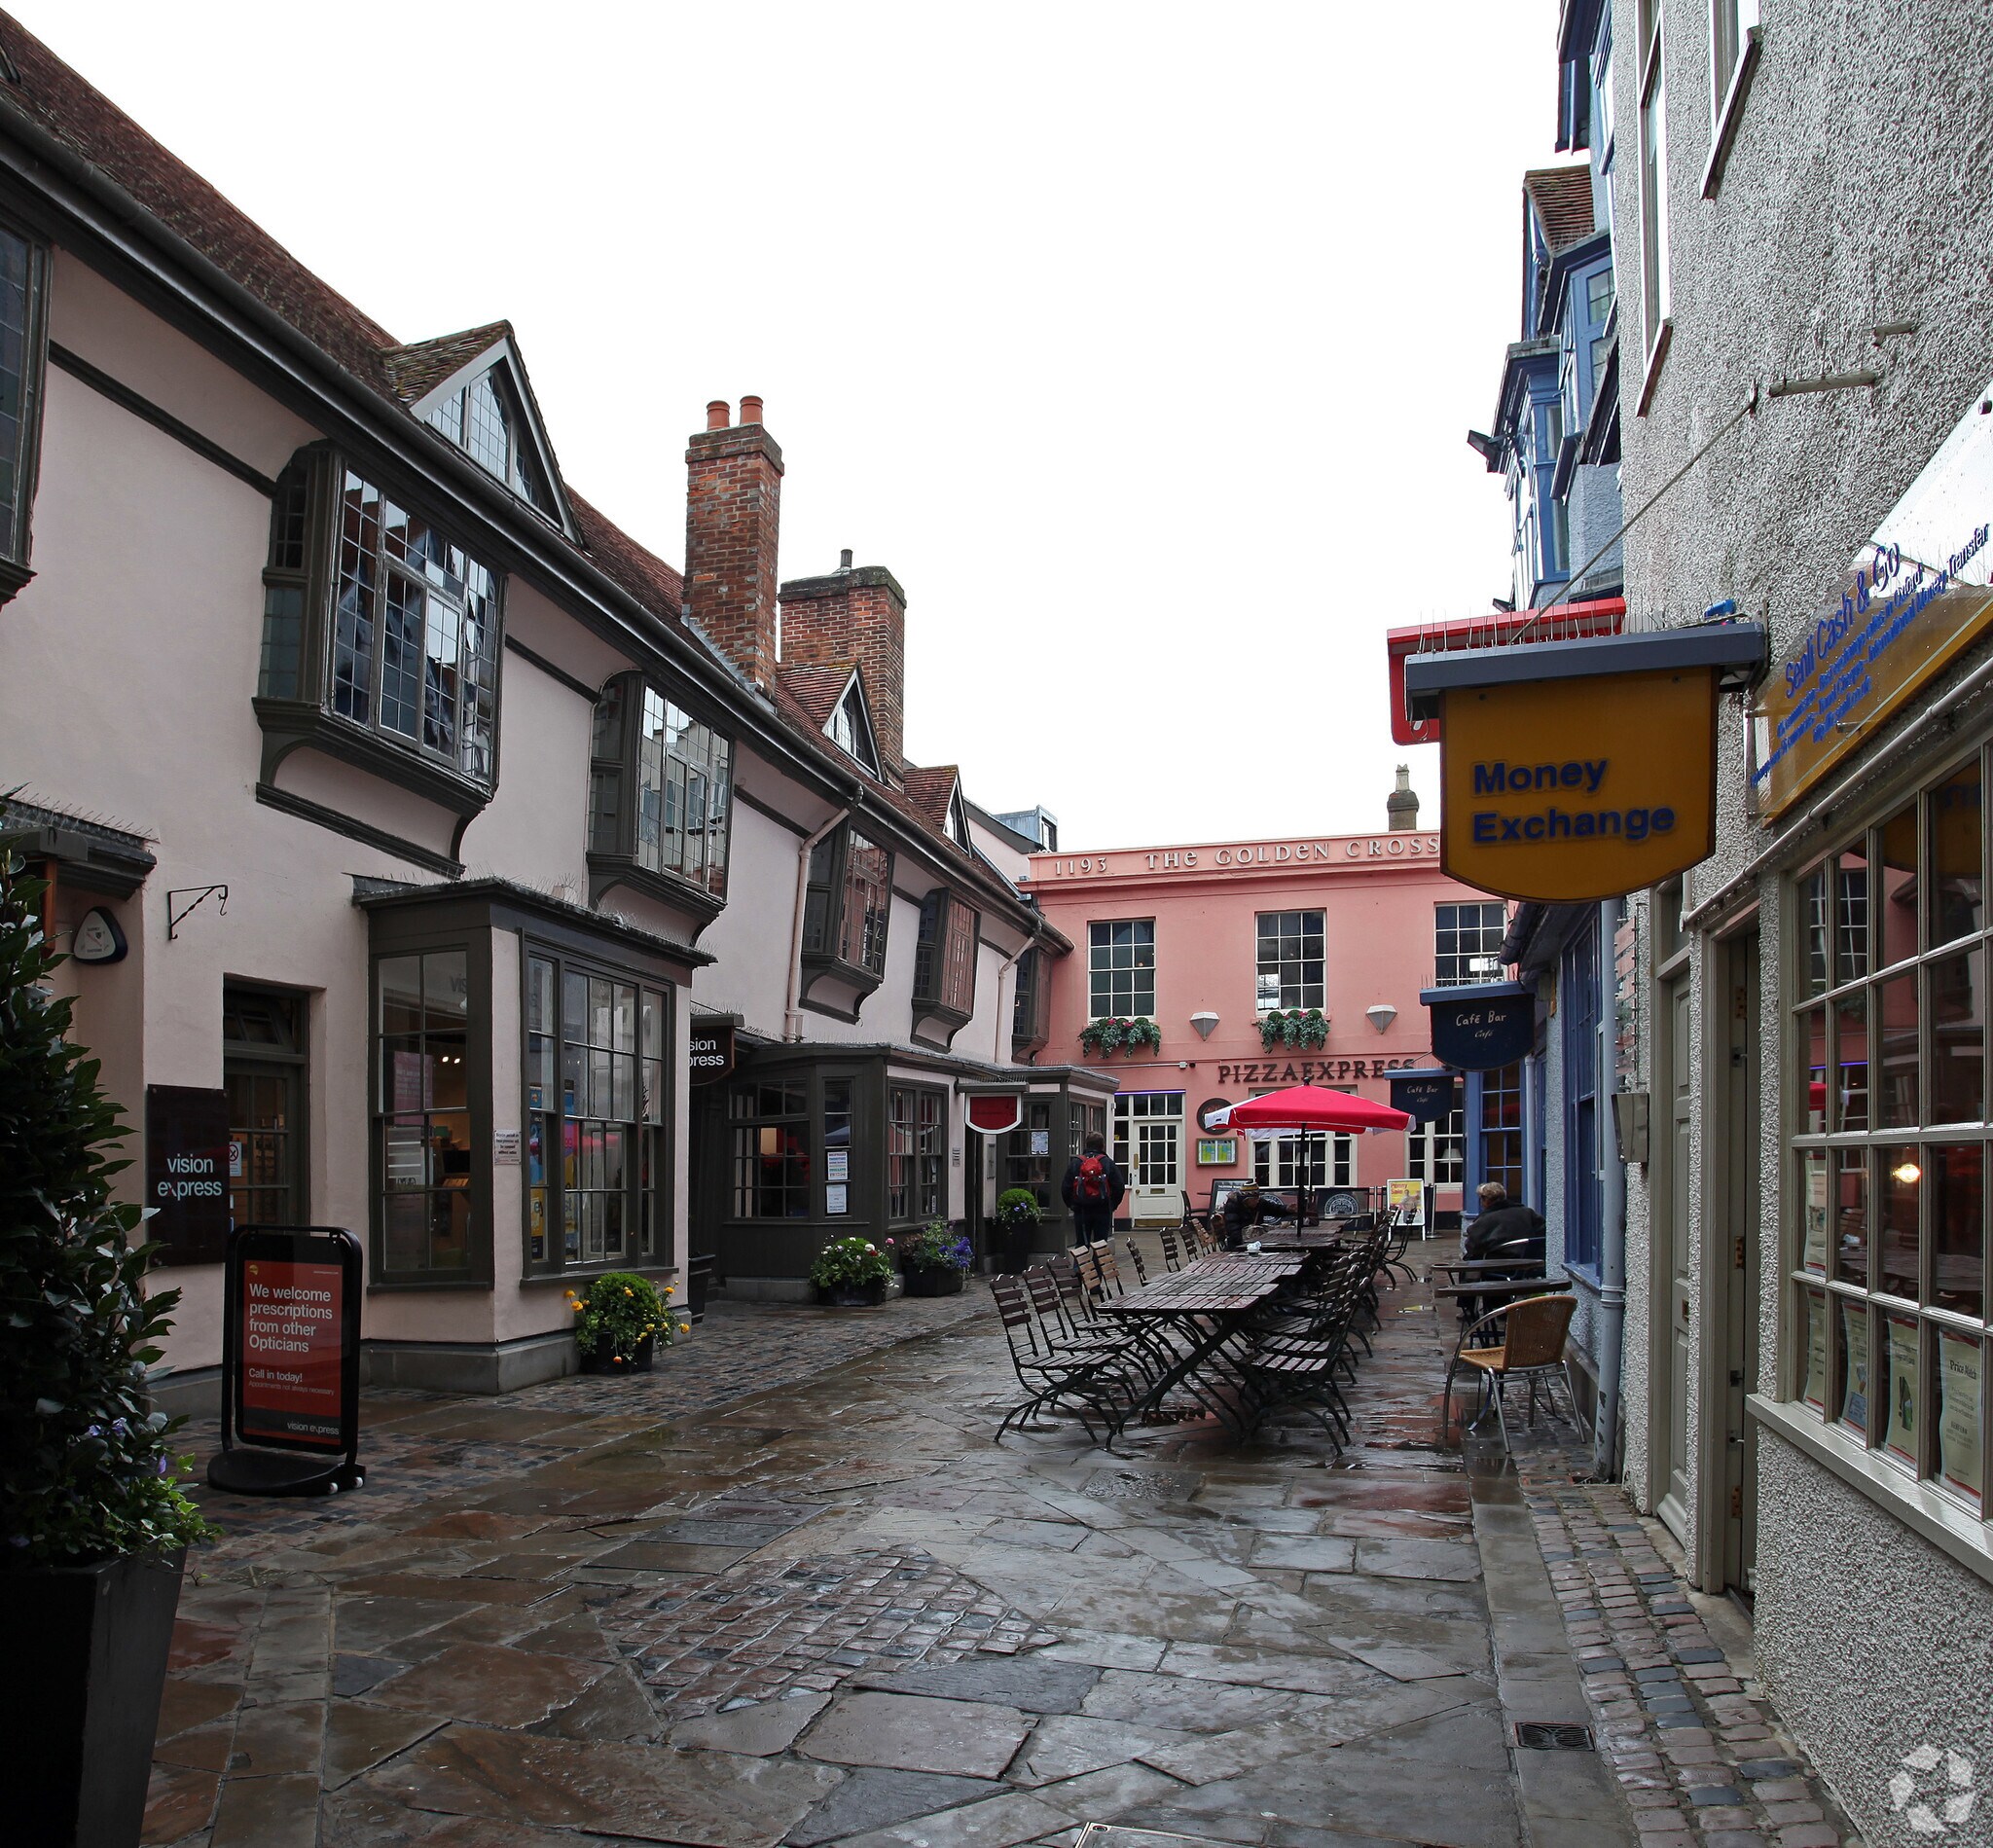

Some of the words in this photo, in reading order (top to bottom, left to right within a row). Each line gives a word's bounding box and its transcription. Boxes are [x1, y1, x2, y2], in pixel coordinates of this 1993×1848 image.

[1916, 569, 1947, 613] Money
[1946, 523, 1990, 580] Transfer
[1785, 633, 1816, 699] Senli
[1817, 592, 1854, 659] Cash
[1856, 569, 1870, 615] &
[1872, 542, 1901, 592] Go
[1472, 759, 1609, 796] Money
[1472, 807, 1676, 844] Exchange
[1055, 856, 1107, 876] 1193
[1345, 836, 1438, 858] CROSS
[1456, 1013, 1481, 1027] Café
[1487, 1010, 1507, 1024] Bar
[689, 1037, 717, 1051] sion
[1217, 1058, 1415, 1084] PIZZAEXPRESS
[1426, 1084, 1438, 1094] Bar
[166, 1153, 214, 1174] vision
[157, 1180, 222, 1202] express
[249, 1283, 270, 1298] We
[272, 1286, 332, 1302] welcome
[249, 1302, 333, 1320] prescriptions
[249, 1319, 278, 1333] from
[282, 1321, 316, 1337] other
[249, 1334, 309, 1353] Opticians
[248, 1367, 266, 1378] Call
[267, 1369, 275, 1380] in
[276, 1371, 303, 1384] today!
[1949, 1359, 1965, 1375] Price
[287, 1421, 308, 1431] vision
[309, 1425, 340, 1435] express
